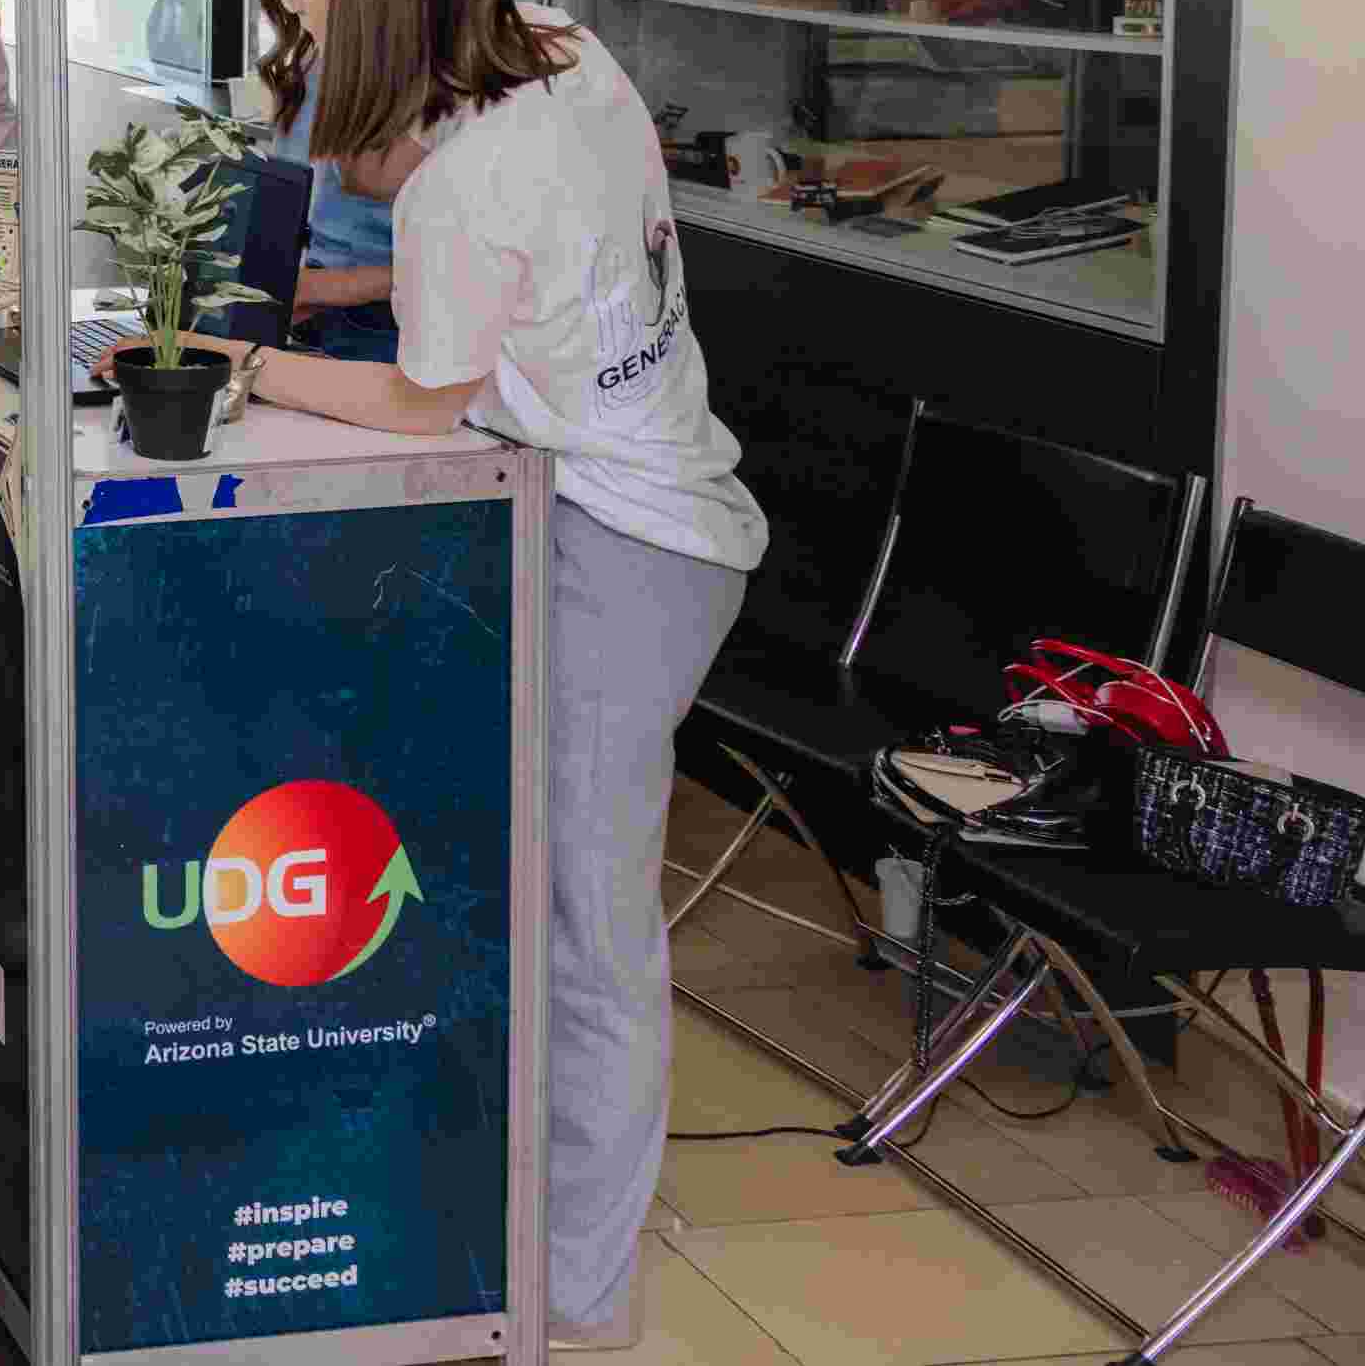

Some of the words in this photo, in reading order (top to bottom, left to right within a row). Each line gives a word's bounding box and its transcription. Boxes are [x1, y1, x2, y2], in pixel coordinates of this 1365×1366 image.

[142, 847, 327, 930] UDG
[144, 1016, 211, 1036] Powered
[214, 1015, 233, 1032] by
[144, 1039, 235, 1066] Arizona
[240, 1033, 301, 1056] State
[233, 1195, 349, 1227] #inspire
[227, 1234, 357, 1266] #prepare
[224, 1264, 359, 1299] #succeed
